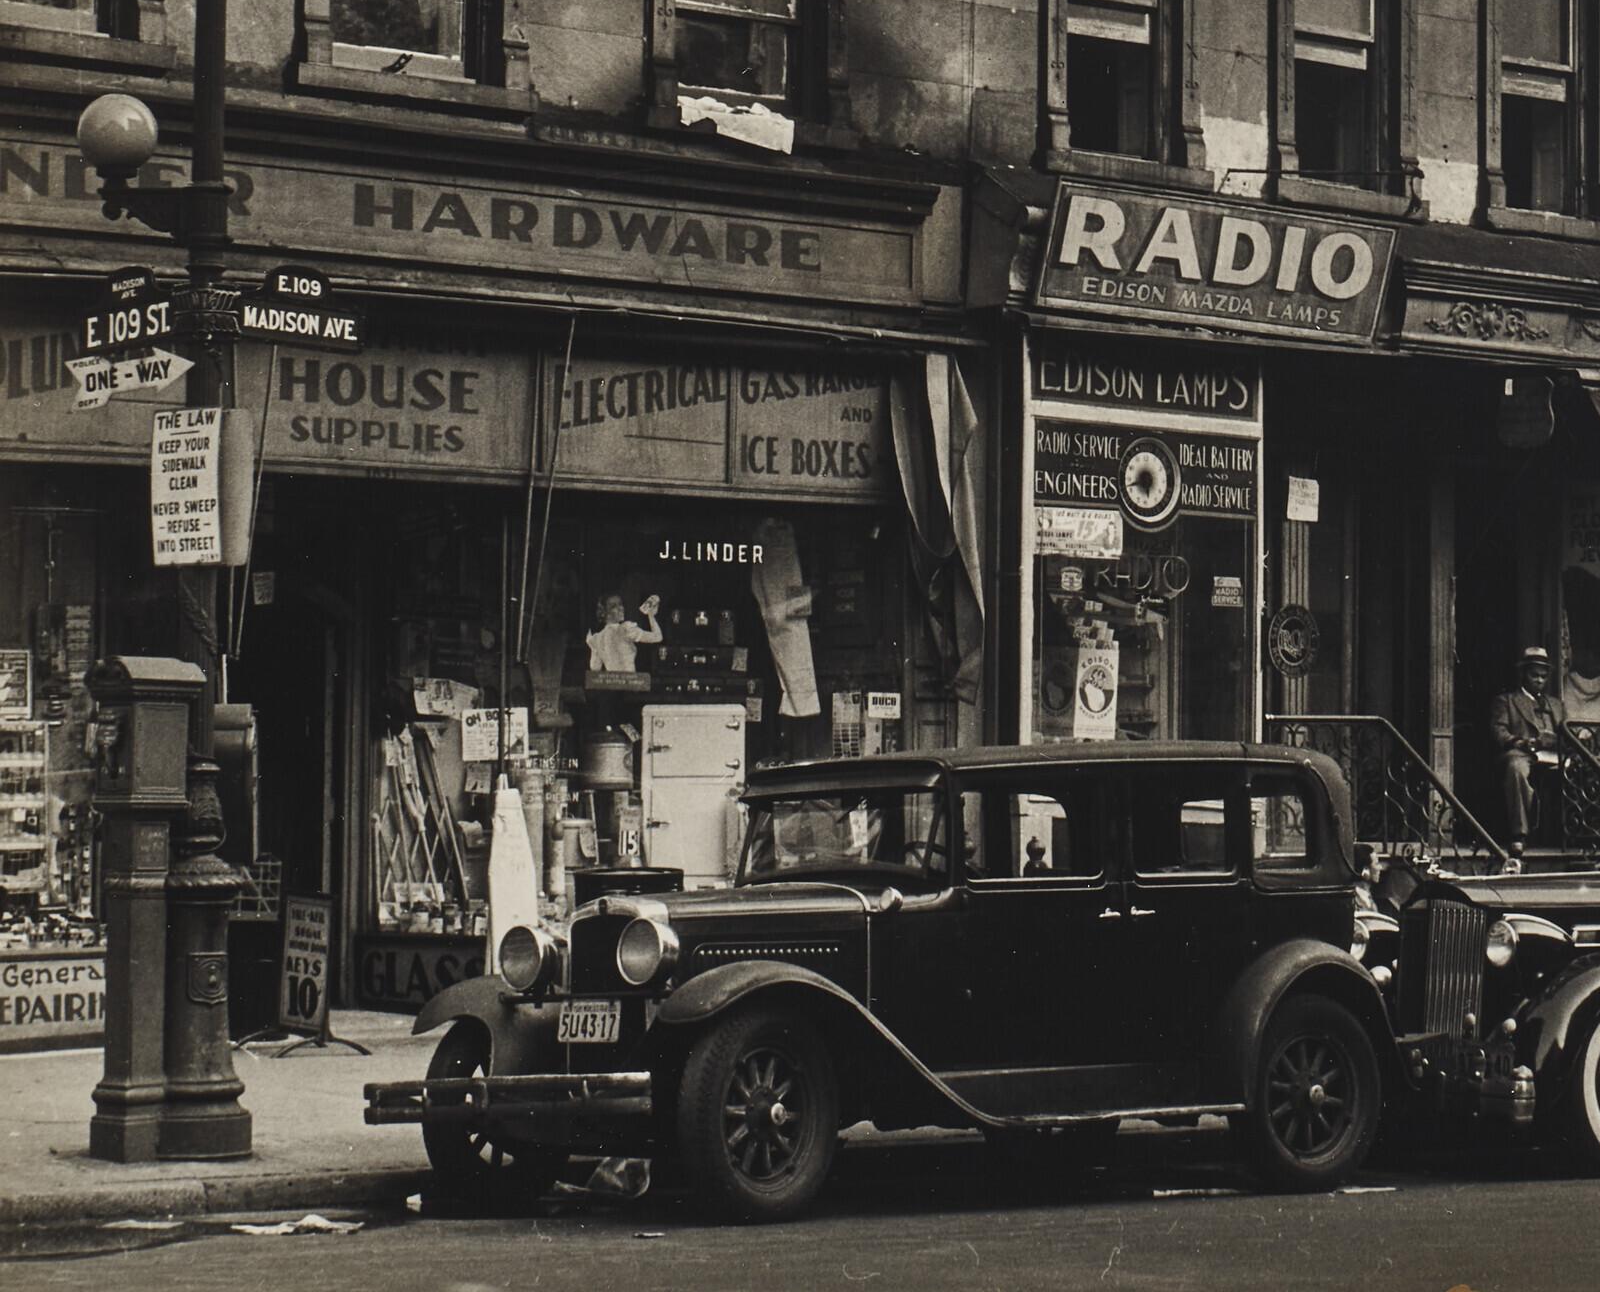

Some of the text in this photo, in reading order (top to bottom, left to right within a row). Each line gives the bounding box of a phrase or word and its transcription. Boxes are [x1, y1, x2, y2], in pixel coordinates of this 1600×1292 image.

[352, 183, 821, 272] HARDWARE
[1058, 195, 1374, 299] RADIO
[112, 276, 147, 292] MADISON
[1082, 277, 1342, 326] EDISON MAZDA LAMPS
[109, 308, 140, 344] 109
[244, 305, 321, 335] MADISON
[279, 357, 479, 414] HOUSE
[553, 364, 727, 429] ELECTRICAL
[740, 364, 800, 404] GAS
[1040, 361, 1249, 411] EDISON LAMPS
[157, 410, 216, 431] THE LAW
[840, 407, 872, 423] AND
[158, 437, 210, 454] KEEP YOUR
[290, 414, 465, 453] SUPPLIES
[1037, 429, 1121, 461] RADIO SERVICE
[162, 455, 207, 473] SIDEWALK
[740, 434, 873, 479] ICE BOXES
[1179, 443, 1254, 473] IDEAL BATTERY
[169, 475, 198, 491] CLEAN
[1035, 470, 1118, 501] ENGINEERS
[1205, 472, 1229, 481] AND
[153, 499, 217, 516] NEVER SWEEP
[1181, 484, 1251, 511] RADIO SERVICE
[167, 519, 201, 534] REFUSE
[157, 536, 215, 553] INTO STREET
[466, 710, 501, 727] OH BO
[3, 964, 105, 988] Genera
